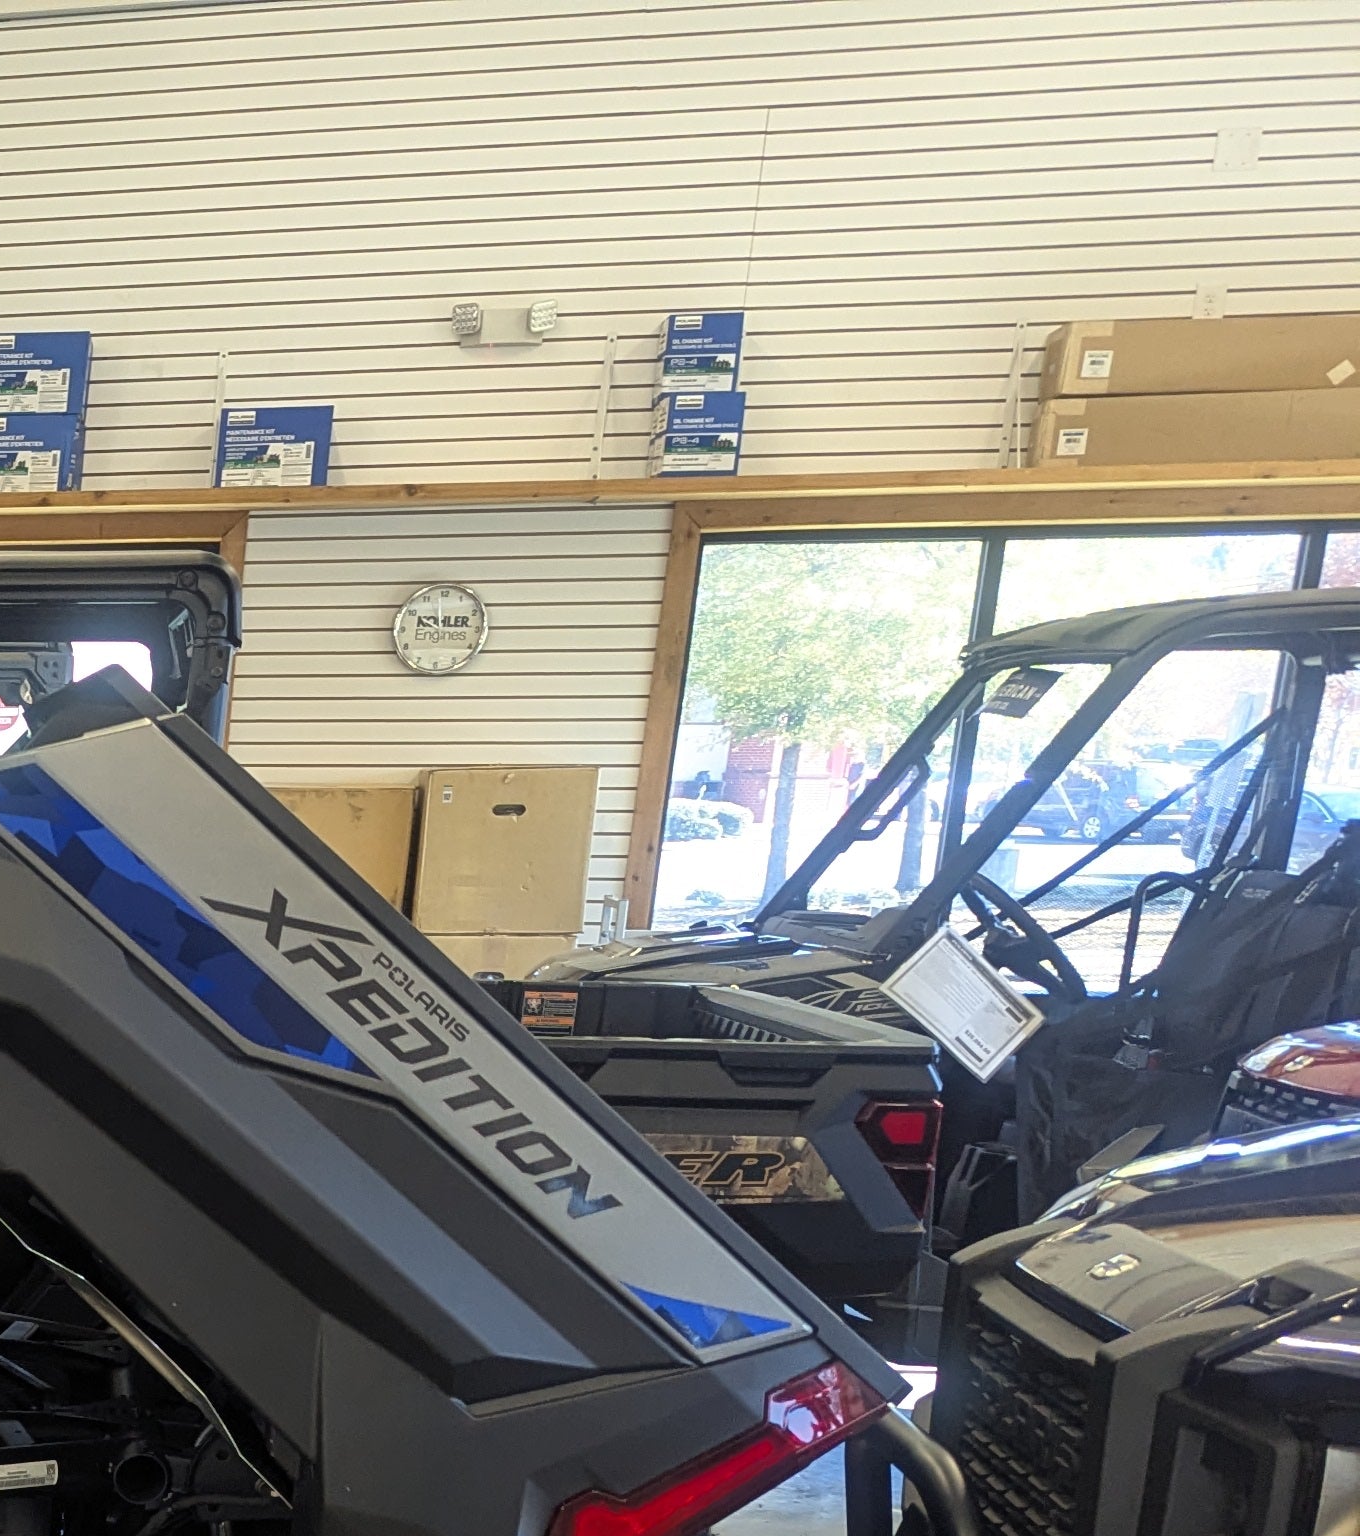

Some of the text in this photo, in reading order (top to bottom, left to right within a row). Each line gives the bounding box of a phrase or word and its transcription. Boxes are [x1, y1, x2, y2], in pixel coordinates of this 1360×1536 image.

[414, 628, 467, 644] Engines
[416, 615, 470, 628] KOHLER
[372, 951, 471, 1043] POLARIS
[200, 888, 624, 1220] XPEDITION
